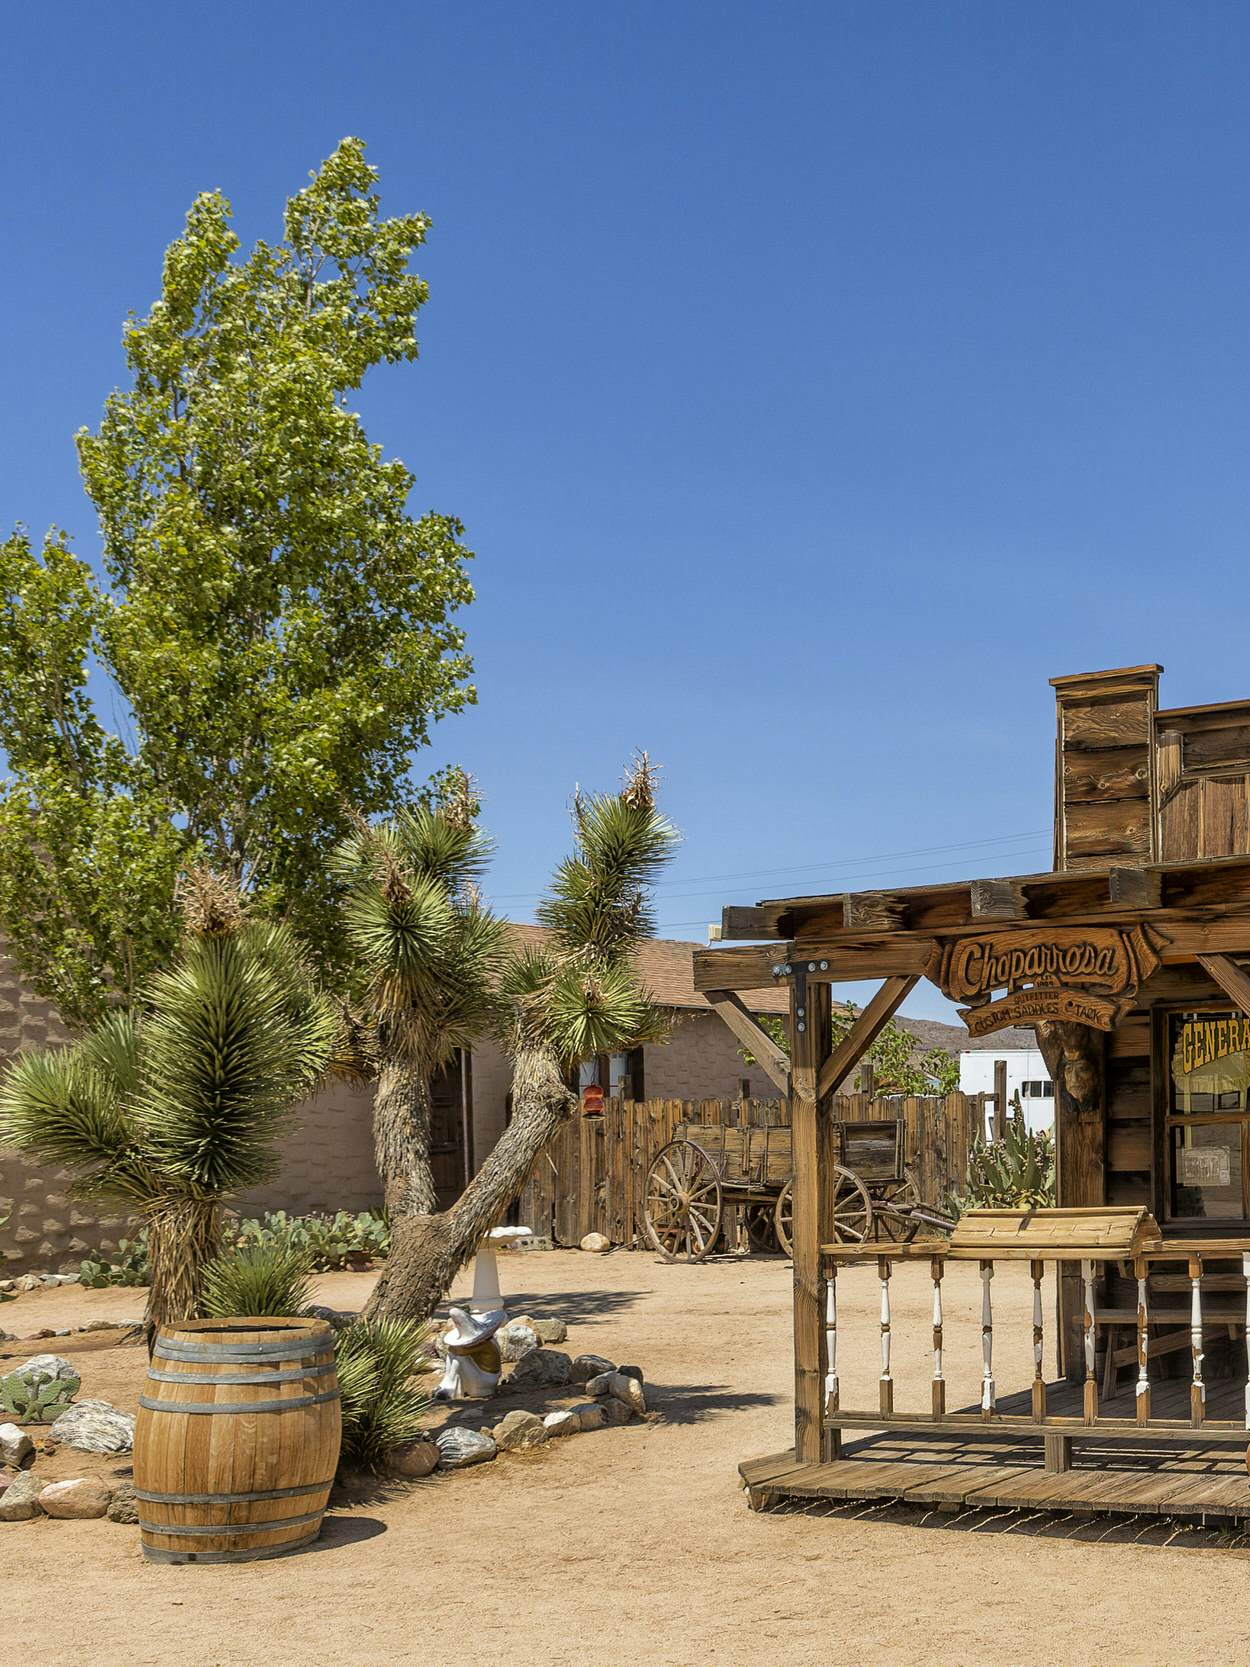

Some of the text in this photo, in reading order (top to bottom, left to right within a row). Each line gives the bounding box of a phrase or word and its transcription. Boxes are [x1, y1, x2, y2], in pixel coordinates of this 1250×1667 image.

[957, 942, 1119, 996] Chaparrosa
[974, 1002, 1102, 1033] CUSTOM SADDLES TACK
